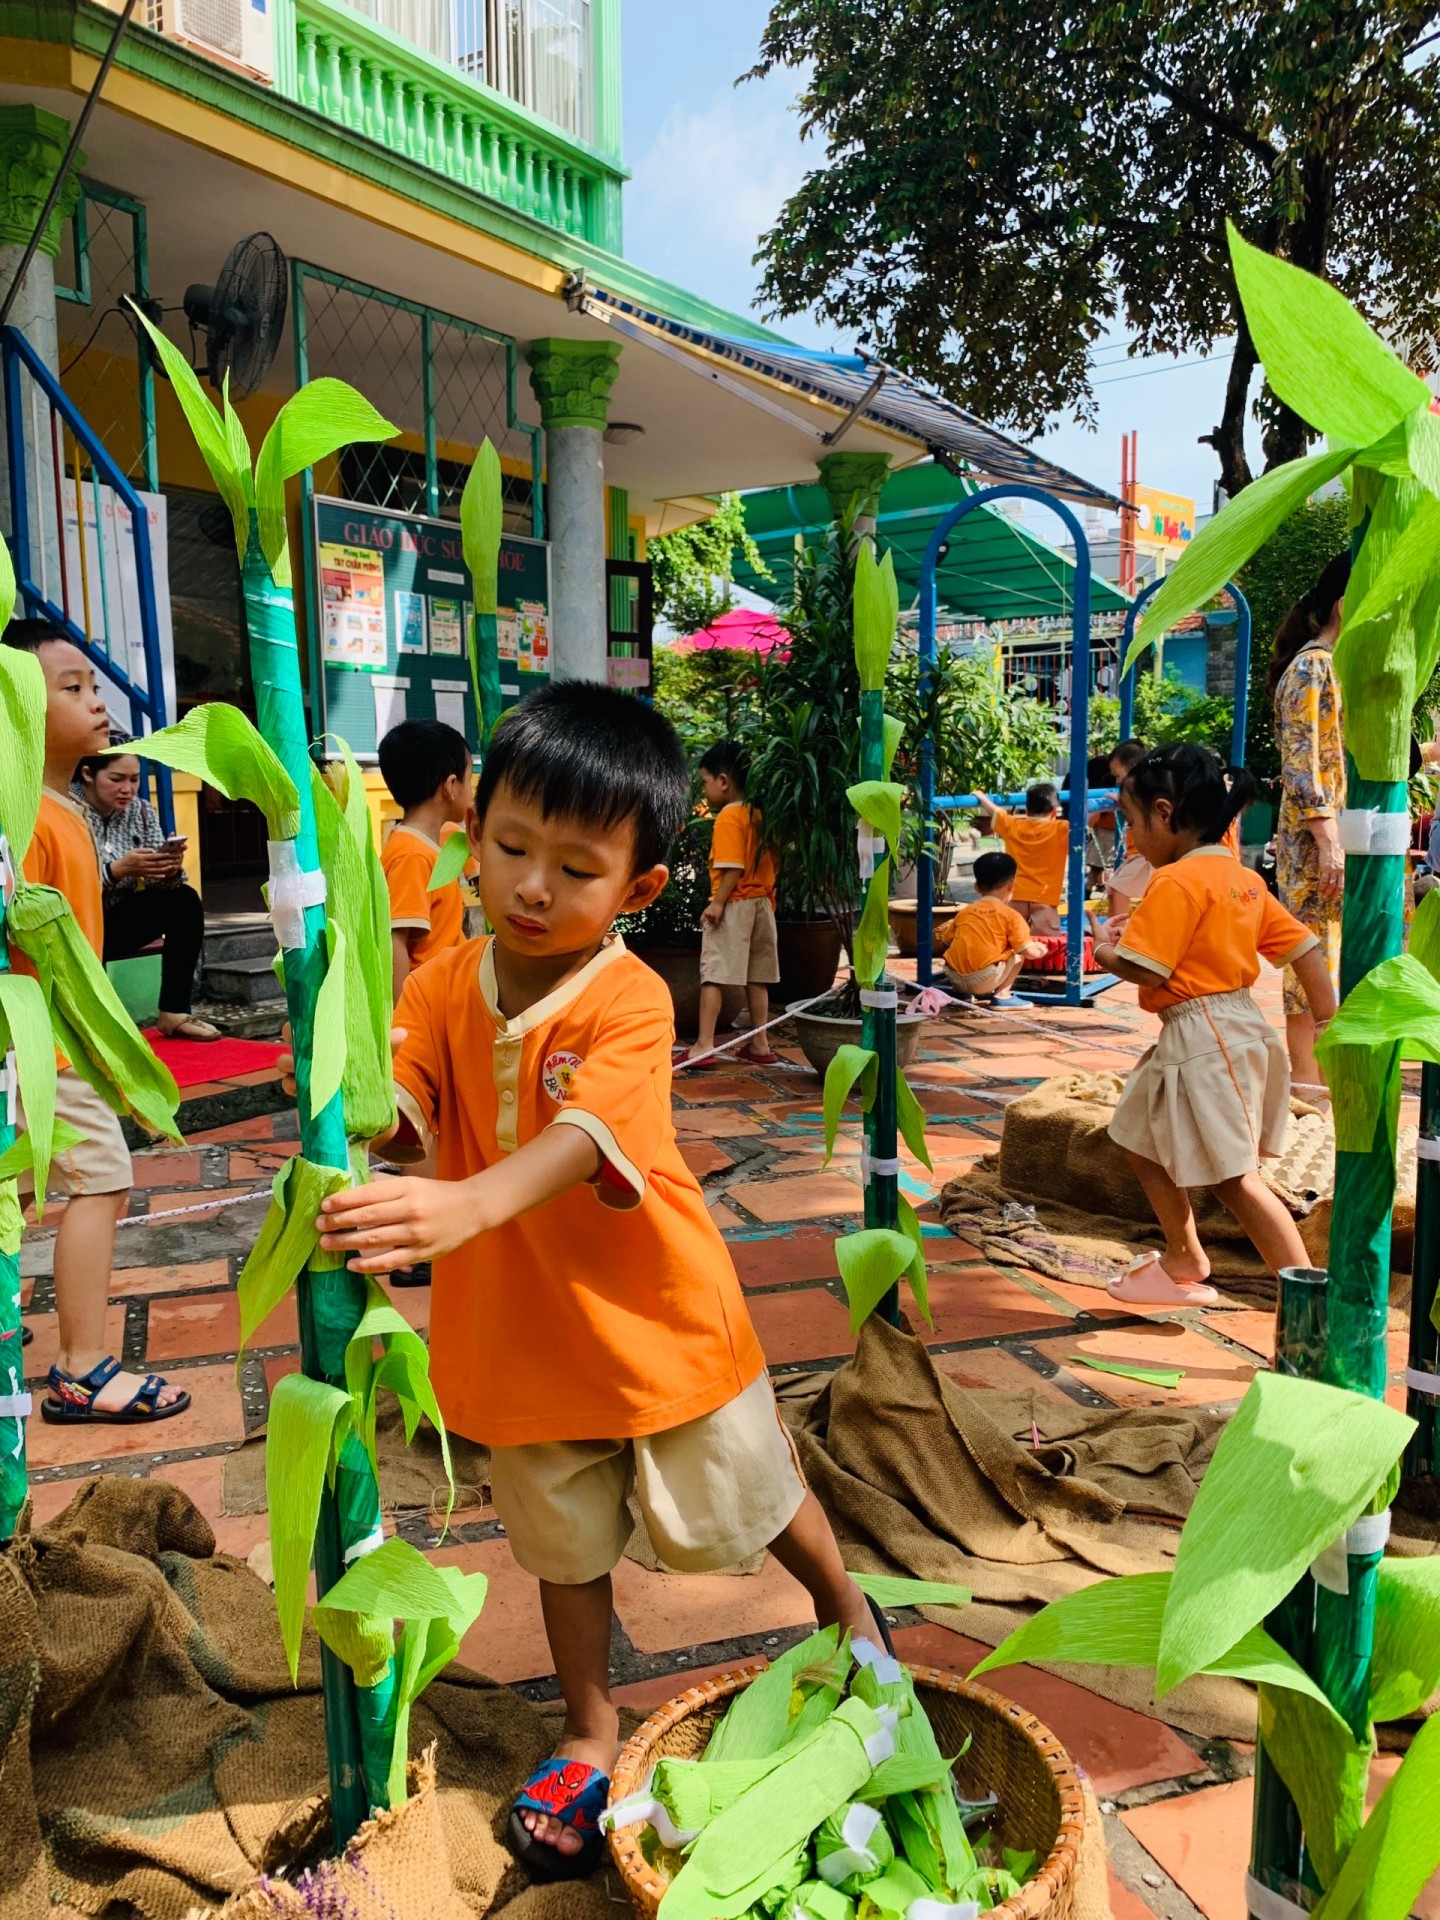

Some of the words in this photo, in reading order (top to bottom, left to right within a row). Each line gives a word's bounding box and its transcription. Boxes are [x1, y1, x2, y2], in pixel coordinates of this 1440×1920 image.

[344, 520, 393, 549] GIÁO
[401, 530, 436, 558] DỤC
[545, 1077, 559, 1092] Bé
